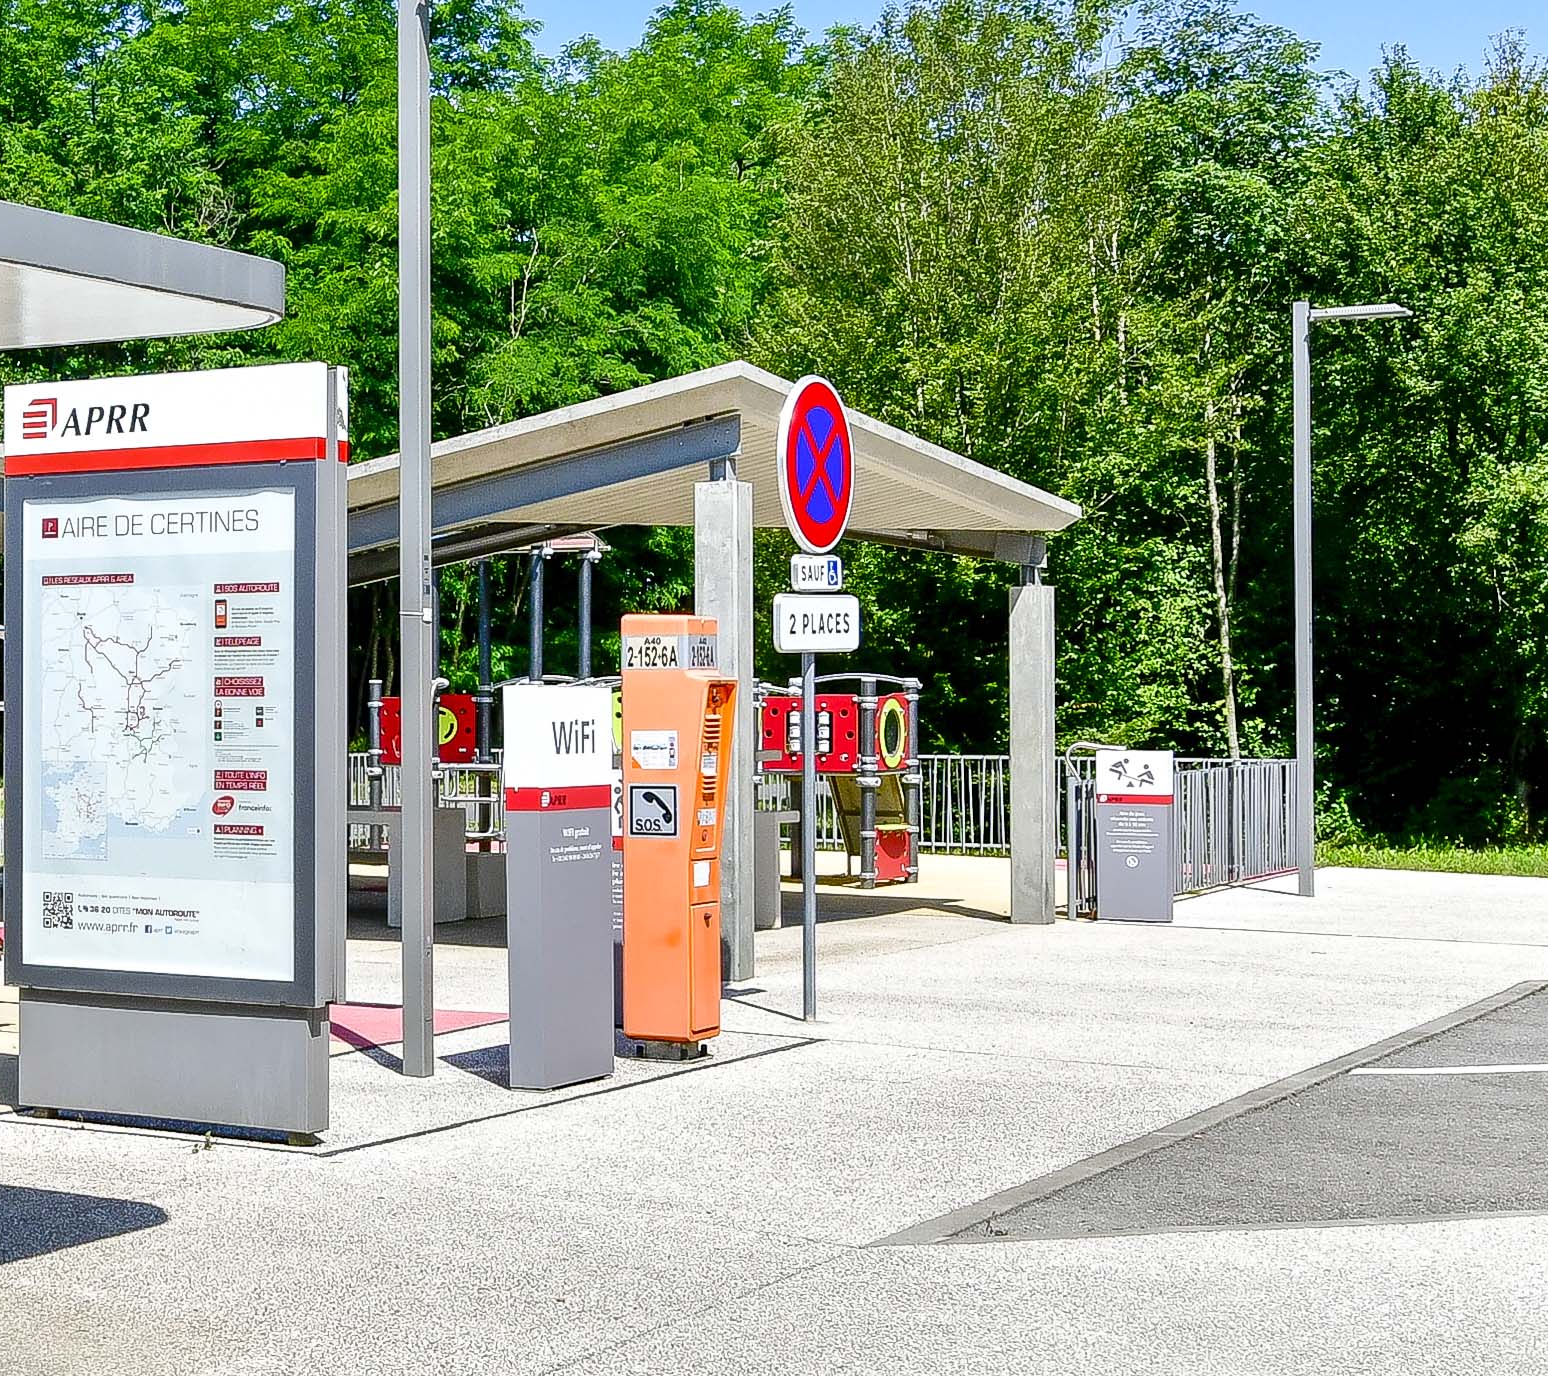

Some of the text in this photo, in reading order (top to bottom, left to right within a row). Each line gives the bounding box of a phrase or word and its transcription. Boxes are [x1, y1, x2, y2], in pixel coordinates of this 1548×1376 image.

[61, 403, 150, 437] APRR
[62, 509, 259, 538] AIRE DE CERTINES
[801, 565, 824, 581] SAUF
[224, 583, 279, 592] SOS AUTOROUTE
[789, 612, 850, 635] 2 PLACES
[644, 637, 661, 645] A40
[552, 719, 595, 754] WiFi
[224, 826, 257, 834] PLANNING
[101, 906, 111, 914] 20
[77, 921, 139, 934] www.aprr.fr
